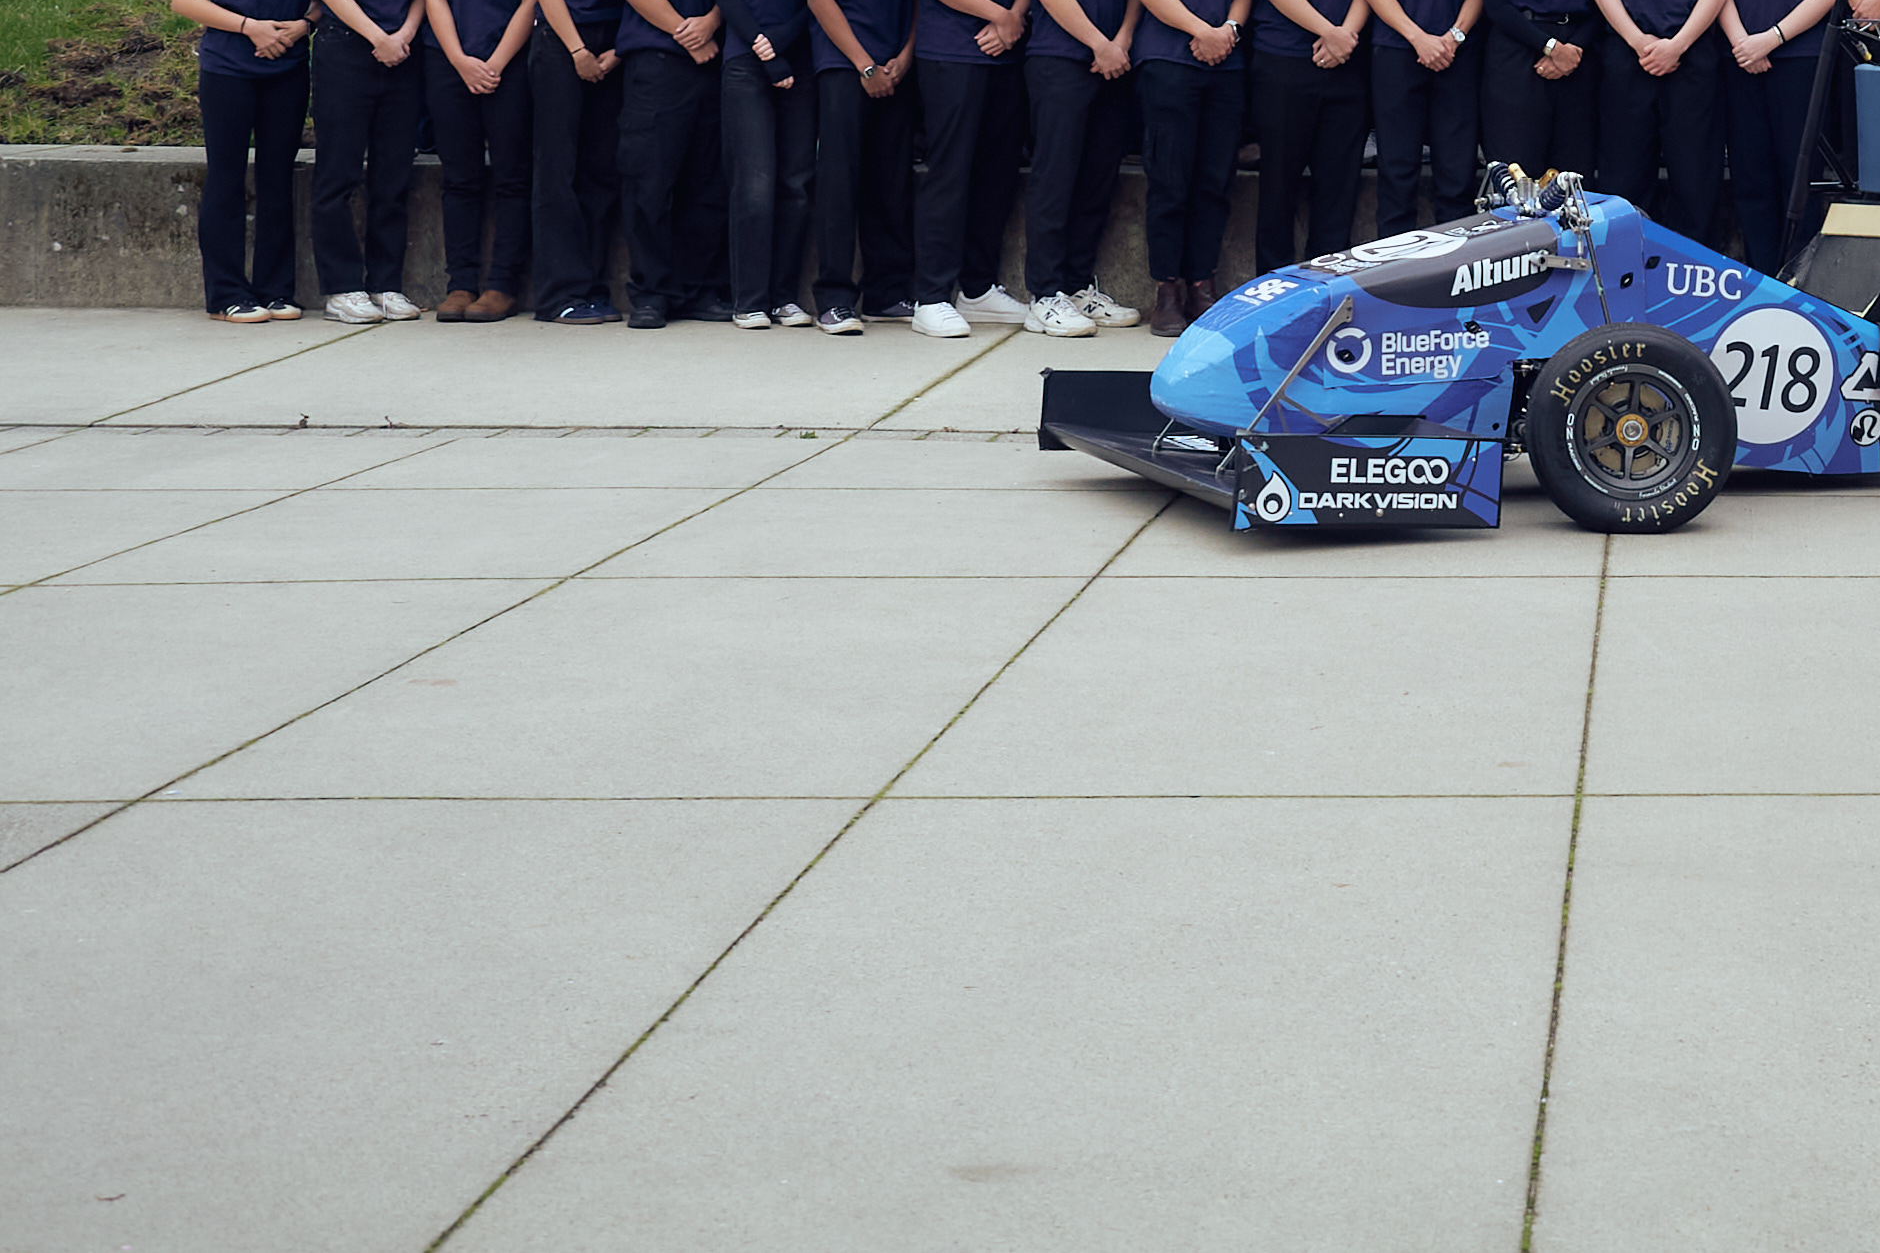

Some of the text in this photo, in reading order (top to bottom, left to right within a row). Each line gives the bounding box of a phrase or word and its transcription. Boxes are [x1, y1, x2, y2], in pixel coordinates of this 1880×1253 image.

[1666, 262, 1743, 300] UBC
[1381, 330, 1490, 353] BlueForce
[1381, 353, 1463, 379] Energy
[1550, 339, 1647, 407] Hoosier
[1725, 341, 1821, 413] 218
[1330, 457, 1450, 485] ELEGOO
[1298, 492, 1458, 510] DARKVISION
[1621, 458, 1719, 526] Hoosier
